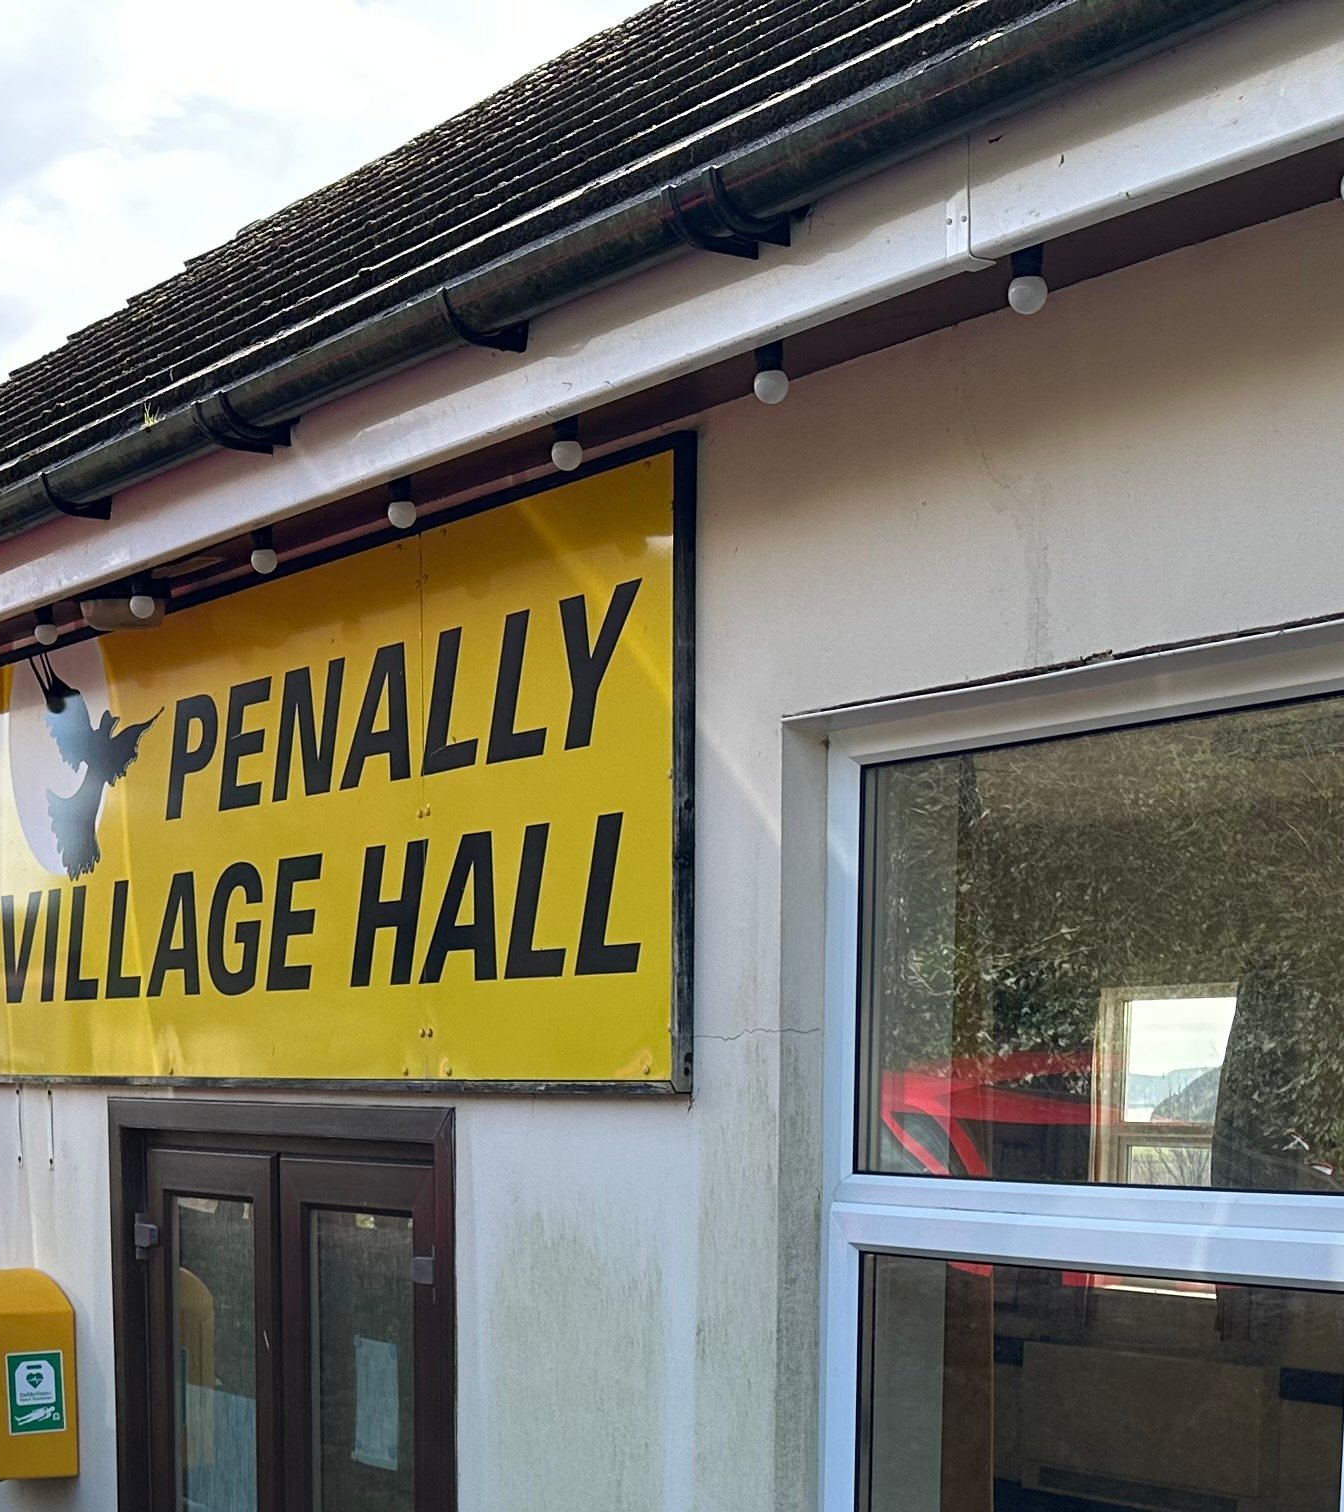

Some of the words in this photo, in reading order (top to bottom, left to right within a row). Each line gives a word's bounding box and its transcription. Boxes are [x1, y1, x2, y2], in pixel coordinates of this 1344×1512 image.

[165, 578, 643, 821] PENALLY
[1, 854, 323, 1004] VILLAGE
[350, 812, 642, 988] HALL
